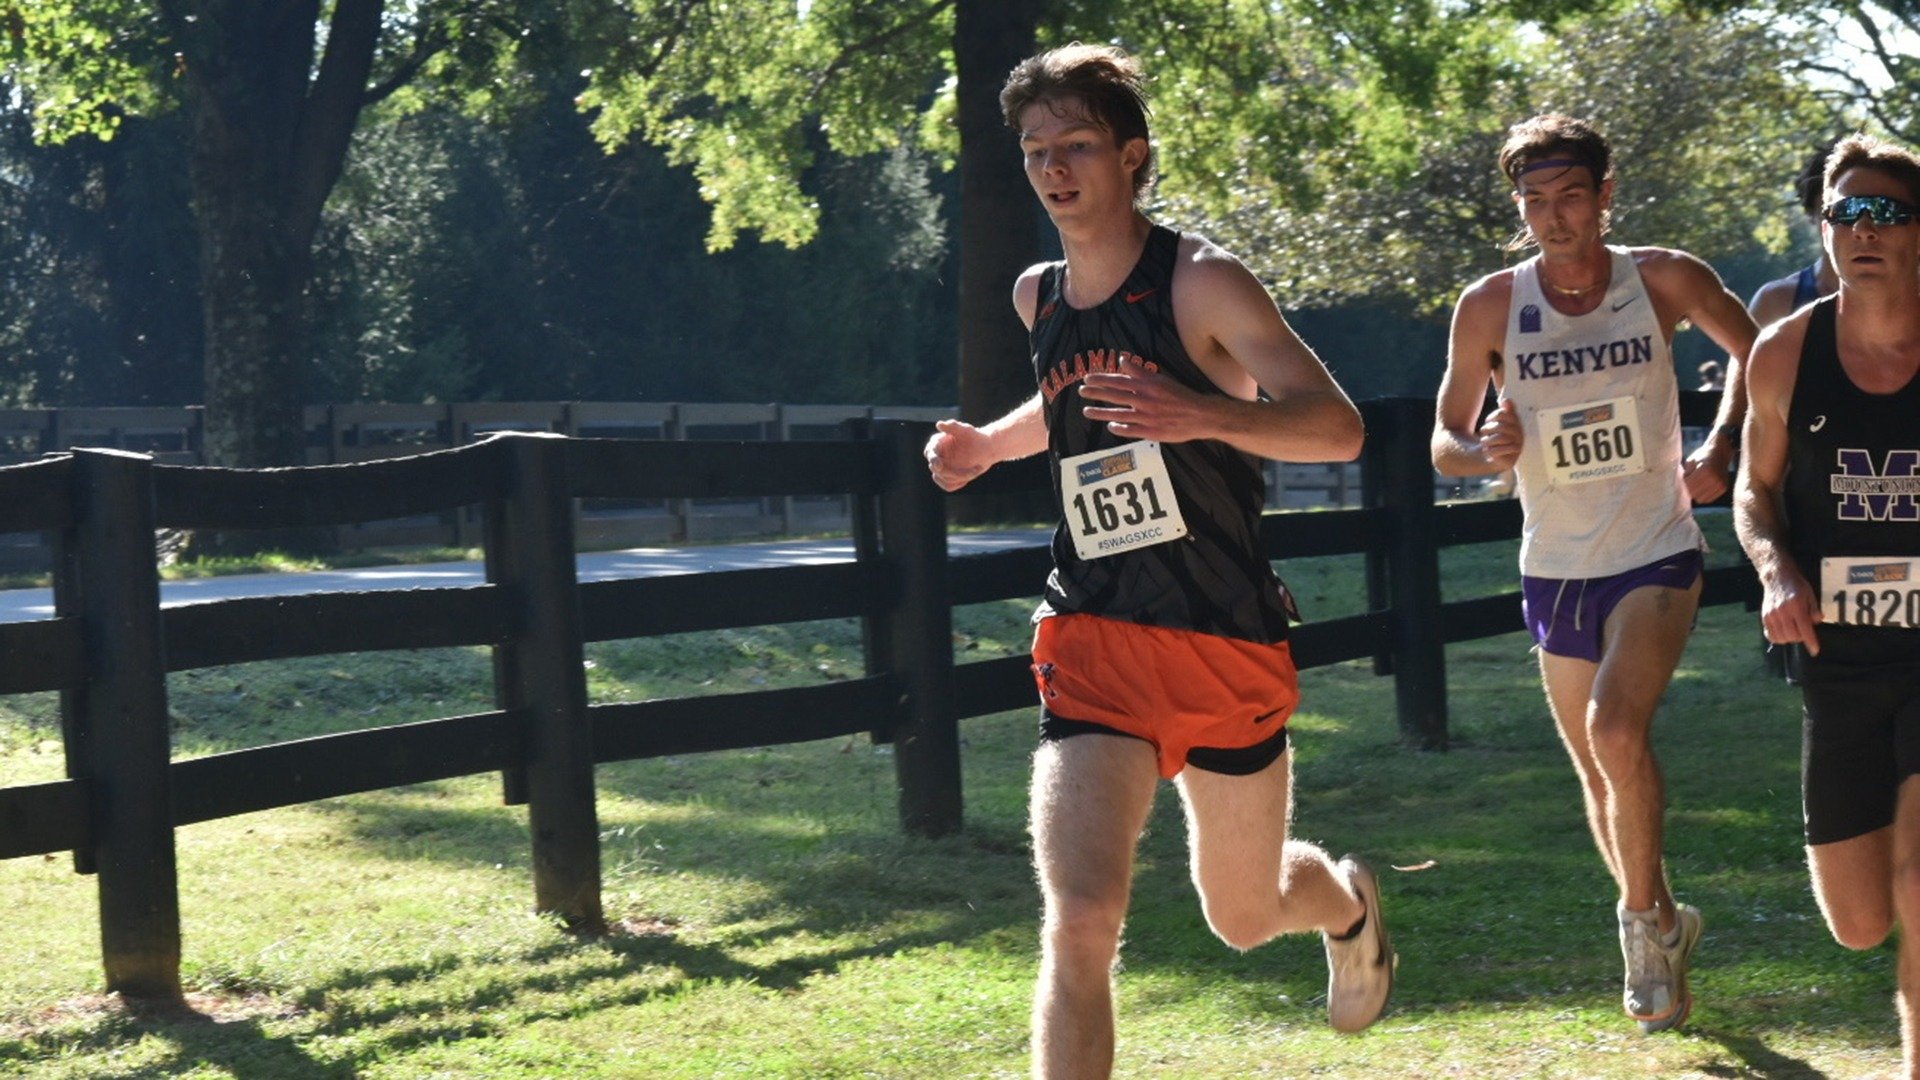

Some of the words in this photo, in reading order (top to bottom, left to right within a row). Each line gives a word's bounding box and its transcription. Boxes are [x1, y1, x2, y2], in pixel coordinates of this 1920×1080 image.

[1516, 335, 1652, 380] KENYON
[1551, 425, 1633, 468] 1660
[1073, 477, 1168, 536] 1631
[1098, 527, 1163, 550] #SWAGSXCC
[1832, 589, 1920, 628] 1820
